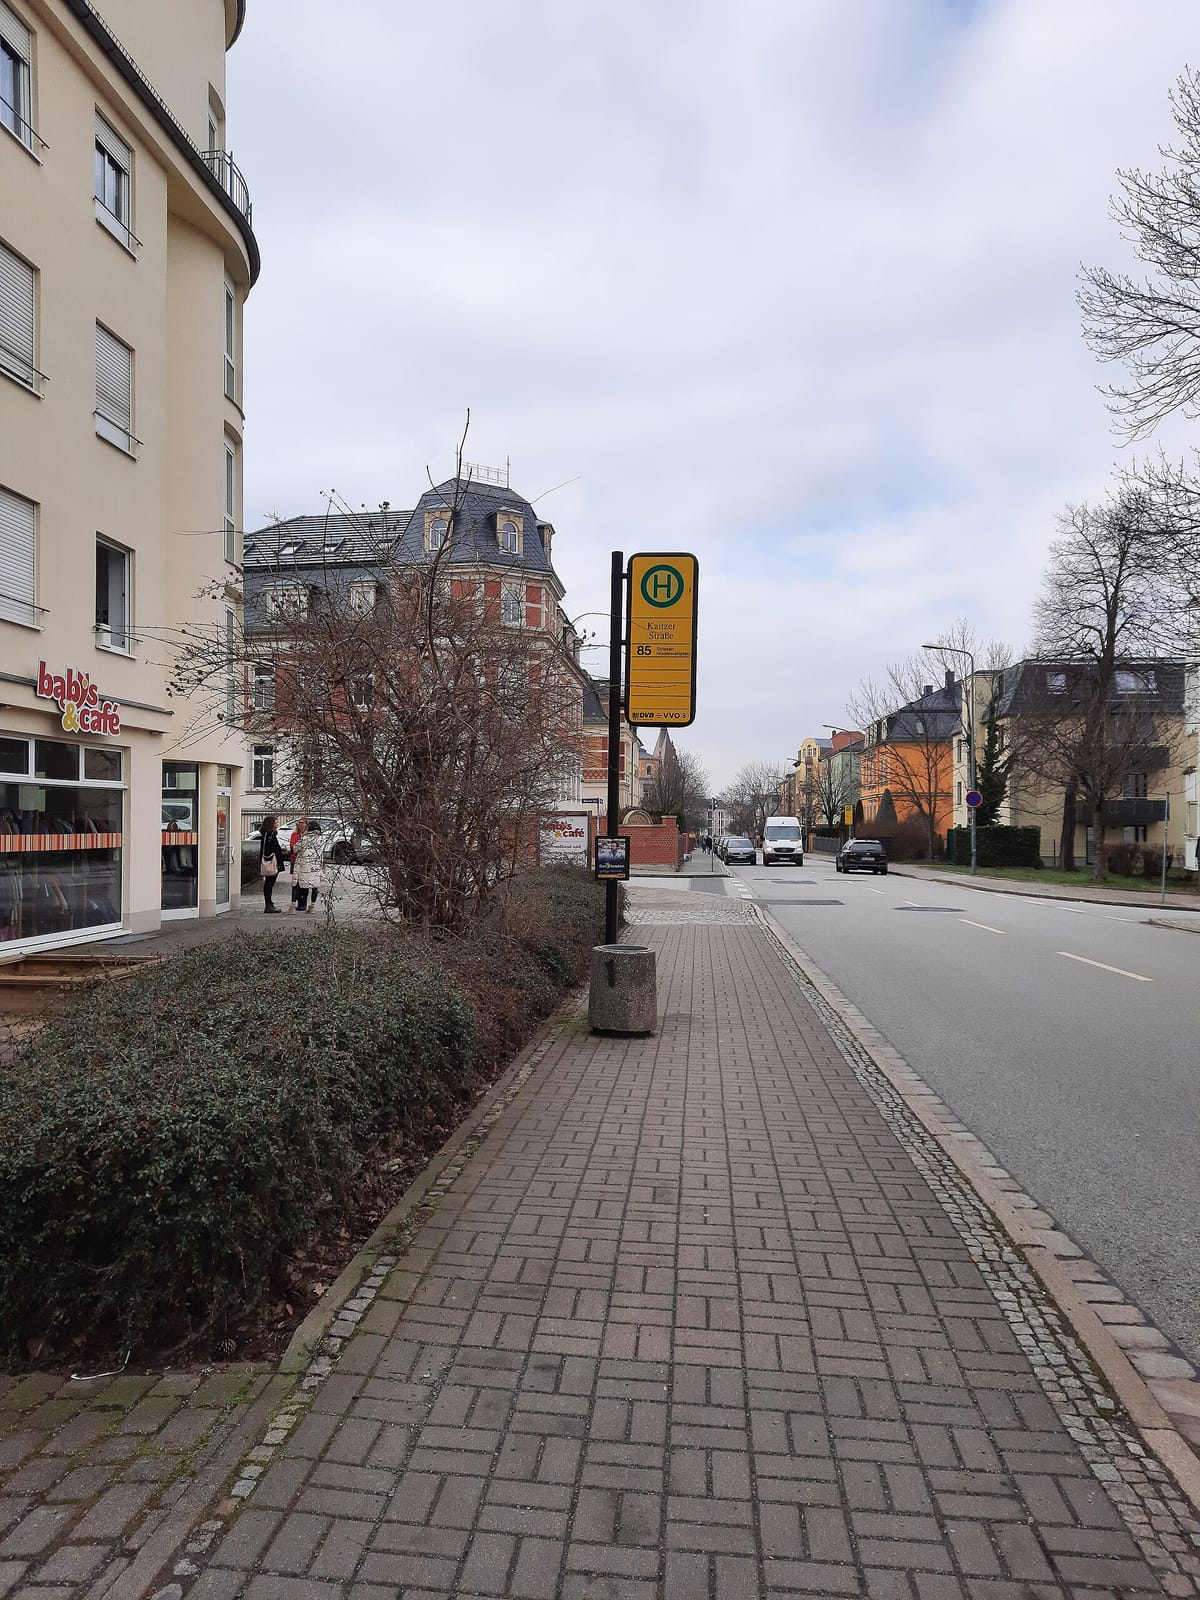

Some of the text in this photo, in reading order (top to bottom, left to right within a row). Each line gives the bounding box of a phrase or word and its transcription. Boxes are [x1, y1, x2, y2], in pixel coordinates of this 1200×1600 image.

[653, 574, 671, 598] H
[647, 622, 676, 630] Kaitzer
[648, 631, 674, 640] Straße
[637, 645, 652, 656] 85
[63, 702, 120, 735] & café
[563, 827, 585, 838] café
